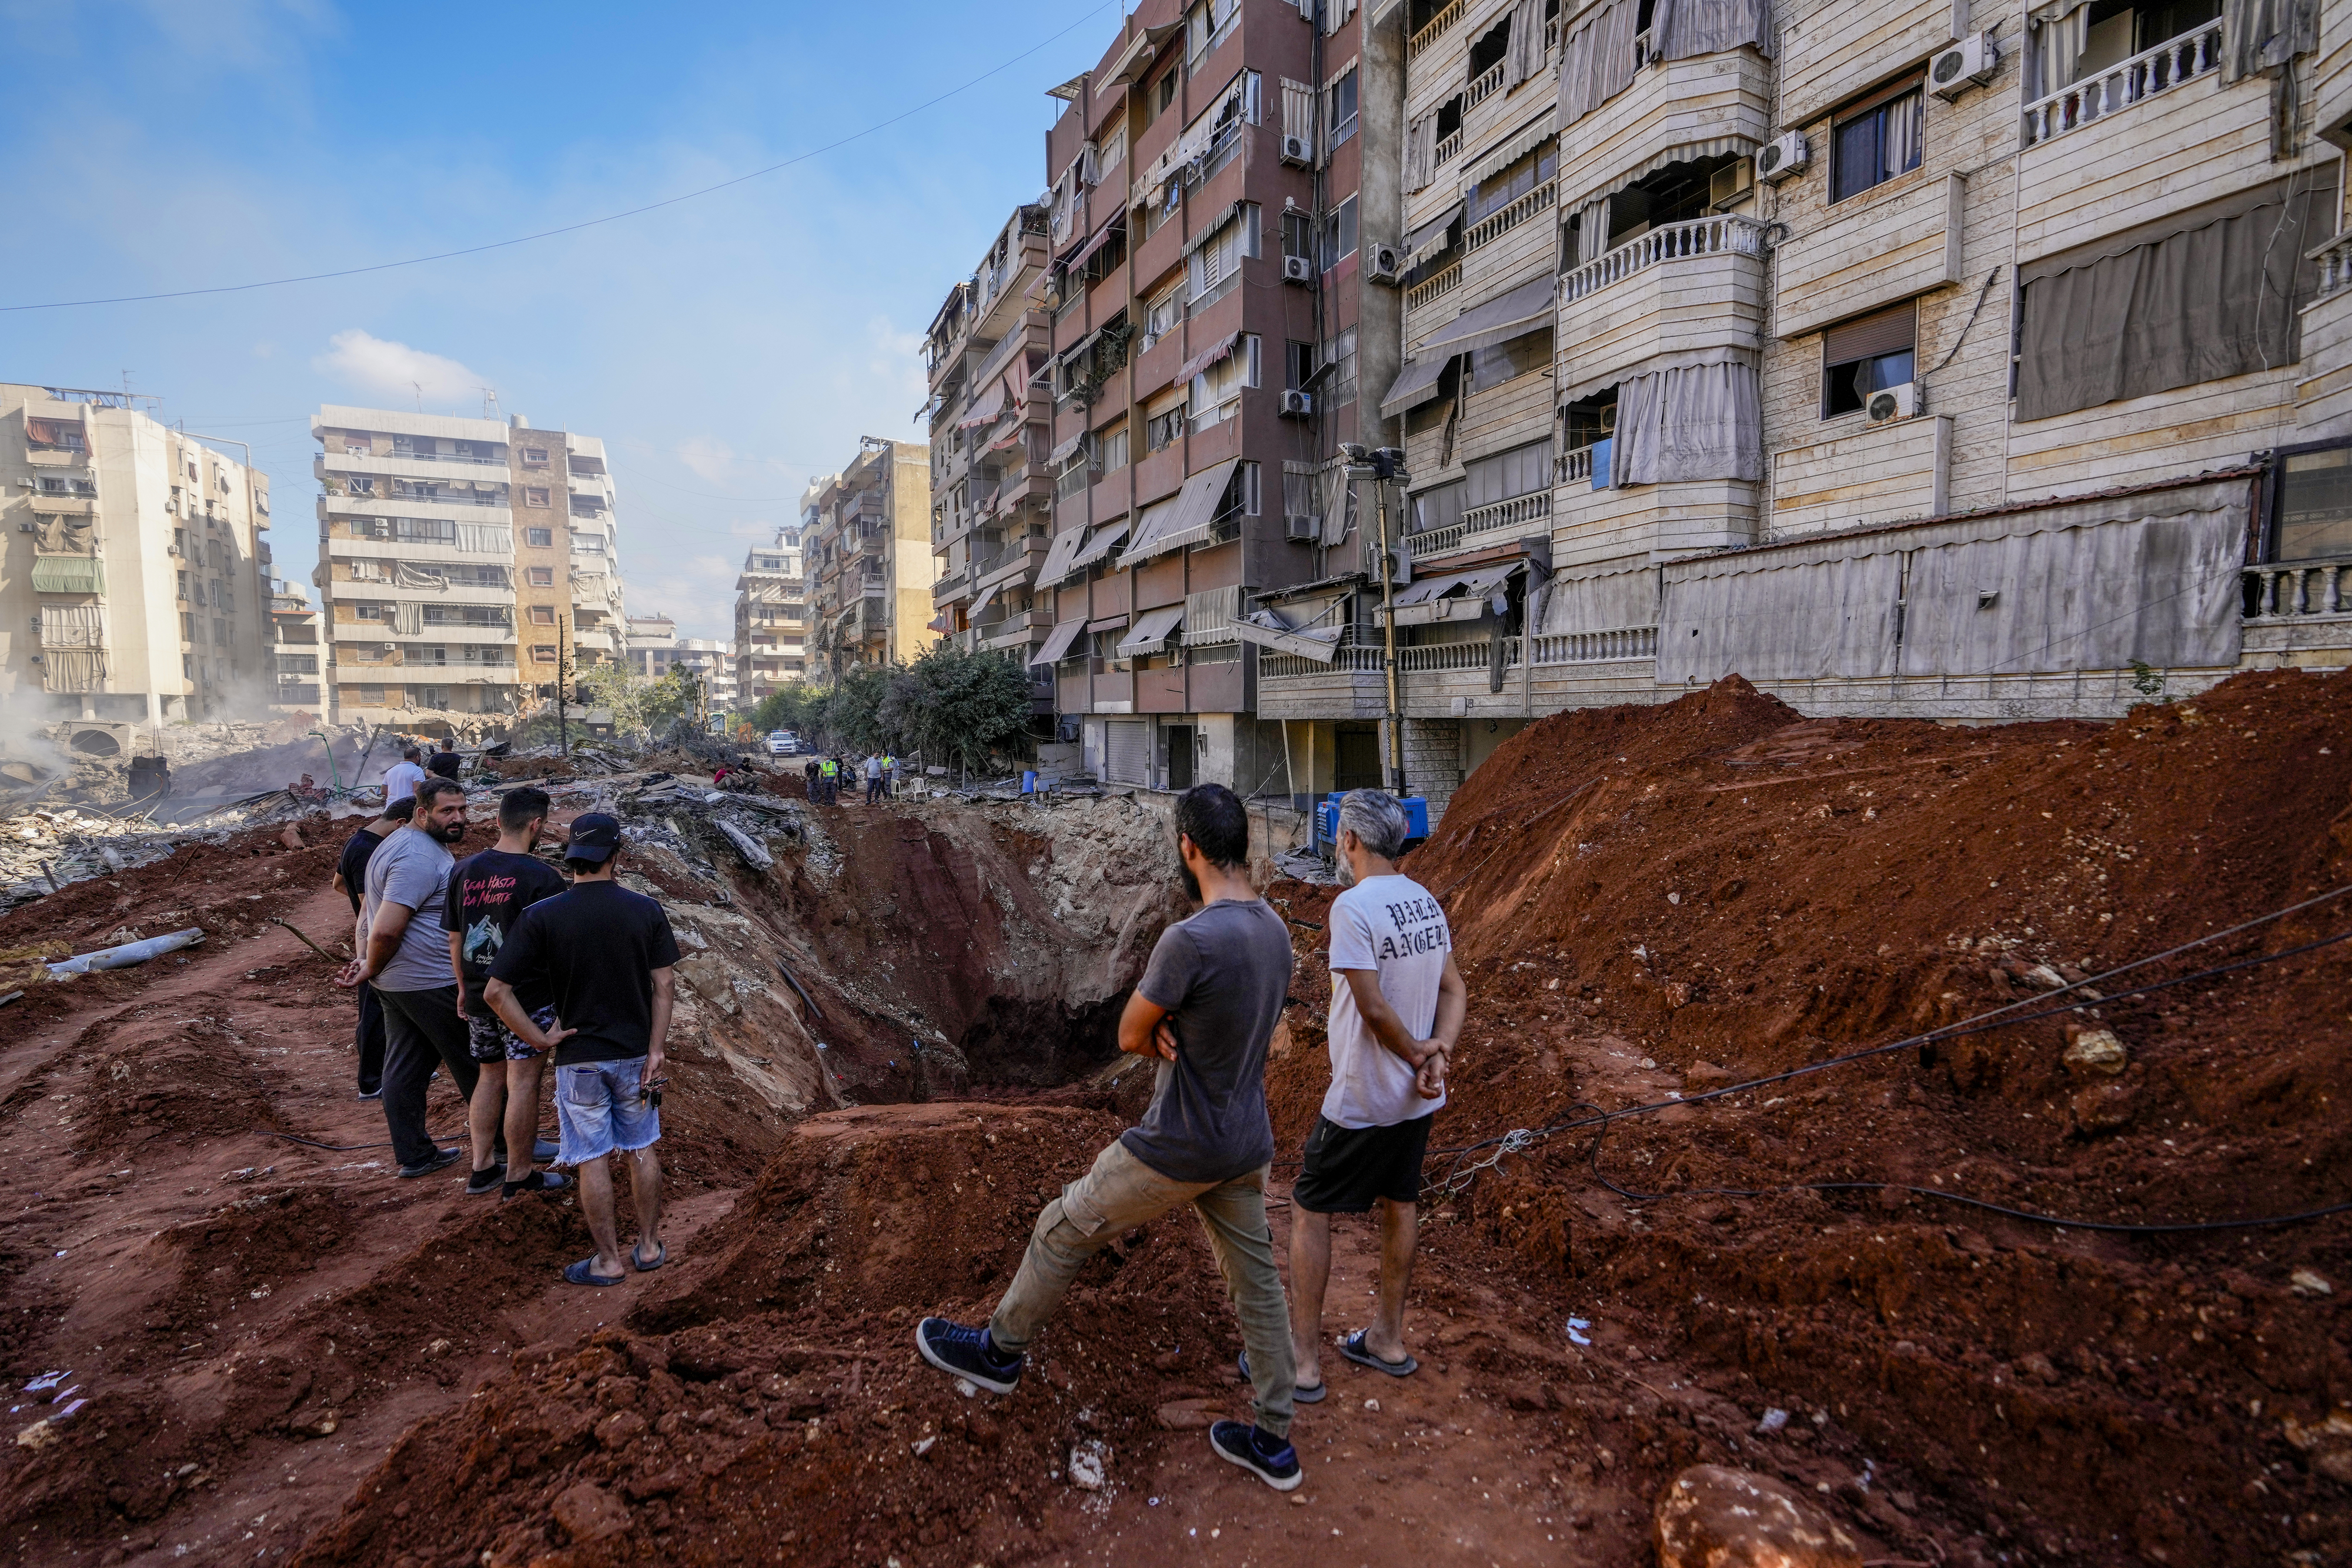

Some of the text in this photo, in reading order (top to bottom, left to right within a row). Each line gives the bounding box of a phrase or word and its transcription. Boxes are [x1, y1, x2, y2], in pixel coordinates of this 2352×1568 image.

[463, 875, 516, 894] REAL HASTA
[477, 890, 513, 907] MUERTE
[1386, 897, 1441, 932] PALM
